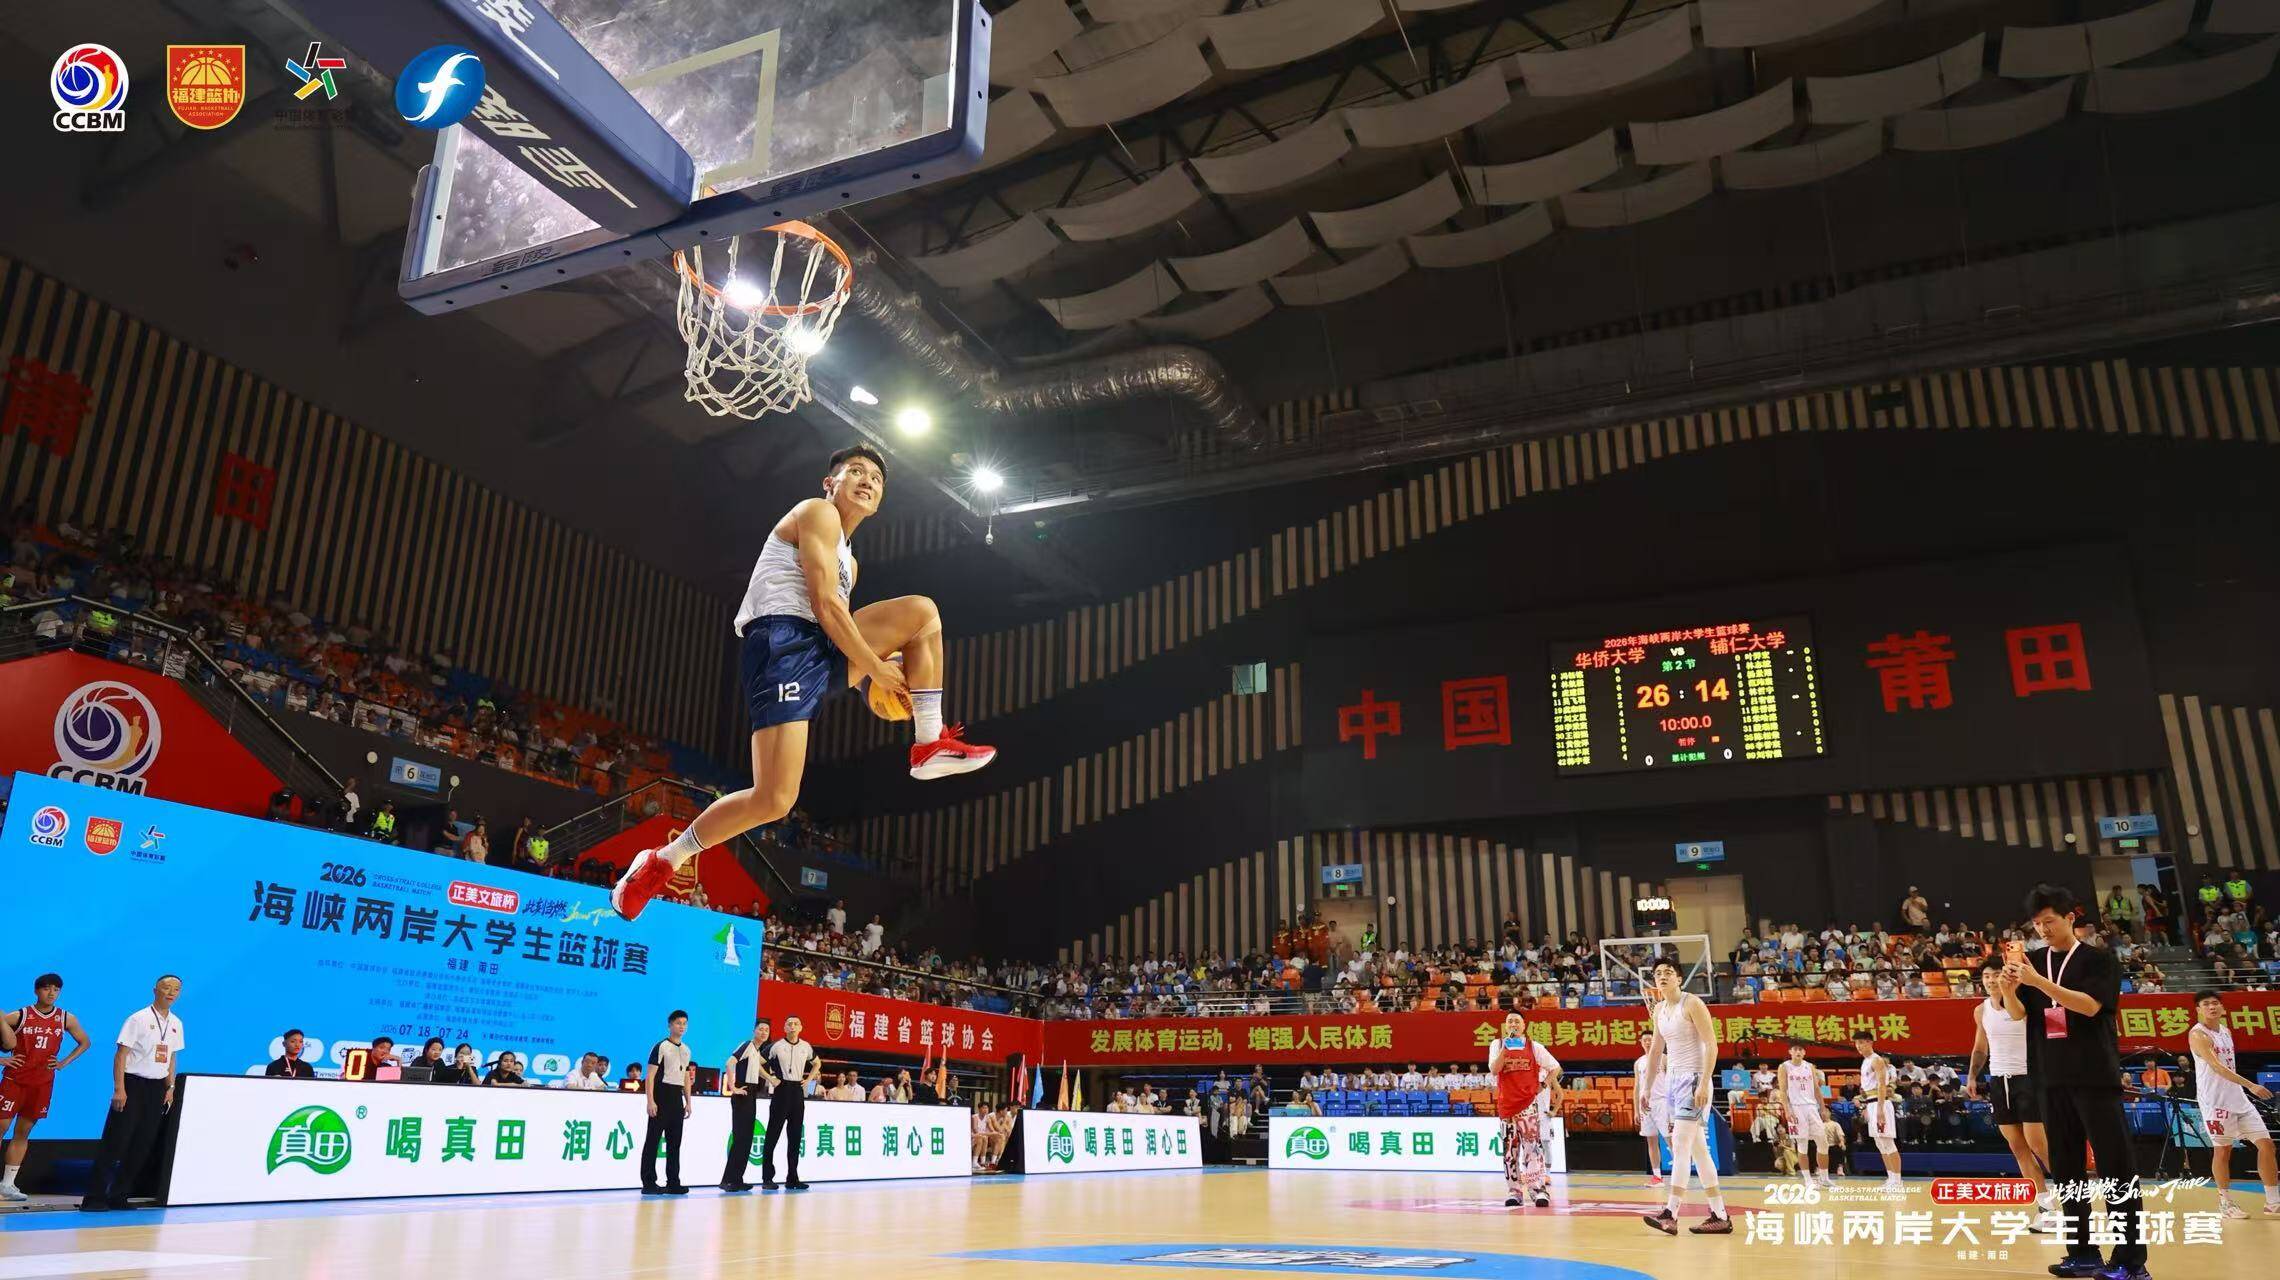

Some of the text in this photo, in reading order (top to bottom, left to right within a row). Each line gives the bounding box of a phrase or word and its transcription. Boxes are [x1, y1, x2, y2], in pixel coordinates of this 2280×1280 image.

[1575, 647, 1645, 669] 华侨大学
[1710, 631, 1785, 655] 辅仁大学
[778, 681, 801, 702] 12
[1338, 675, 1511, 760] 中国
[1865, 622, 2092, 712] 莆田
[1636, 684, 1670, 708] 26
[1695, 678, 1730, 702] 14
[1660, 715, 1712, 731] 10:00.0
[407, 768, 415, 779] 6
[2115, 821, 2129, 831] 10
[31, 835, 63, 847] CCBM
[1691, 847, 1699, 856] 9
[320, 862, 366, 888] 2026
[452, 884, 515, 911] 正美文旅杯
[248, 879, 650, 976] 海峡两岸大学生篮球赛
[35, 1036, 48, 1049] 31
[399, 1024, 413, 1036] 07
[418, 1026, 430, 1037] 18
[456, 1029, 469, 1040] 24
[849, 1009, 994, 1052] 福建省篮球协会
[1091, 1023, 1393, 1052] 发展体育运动，增强人民体质
[346, 1050, 366, 1080] 0
[2, 1100, 15, 1112] 31
[277, 1126, 349, 1164] 真田
[385, 1116, 527, 1163] 喝真田
[799, 1121, 862, 1158] 真田
[882, 1125, 945, 1157] 润心田
[1048, 1124, 1187, 1157] 真田 喝真田 润心田
[1291, 1136, 1327, 1152] 真田
[1349, 1131, 1434, 1155] 喝真田
